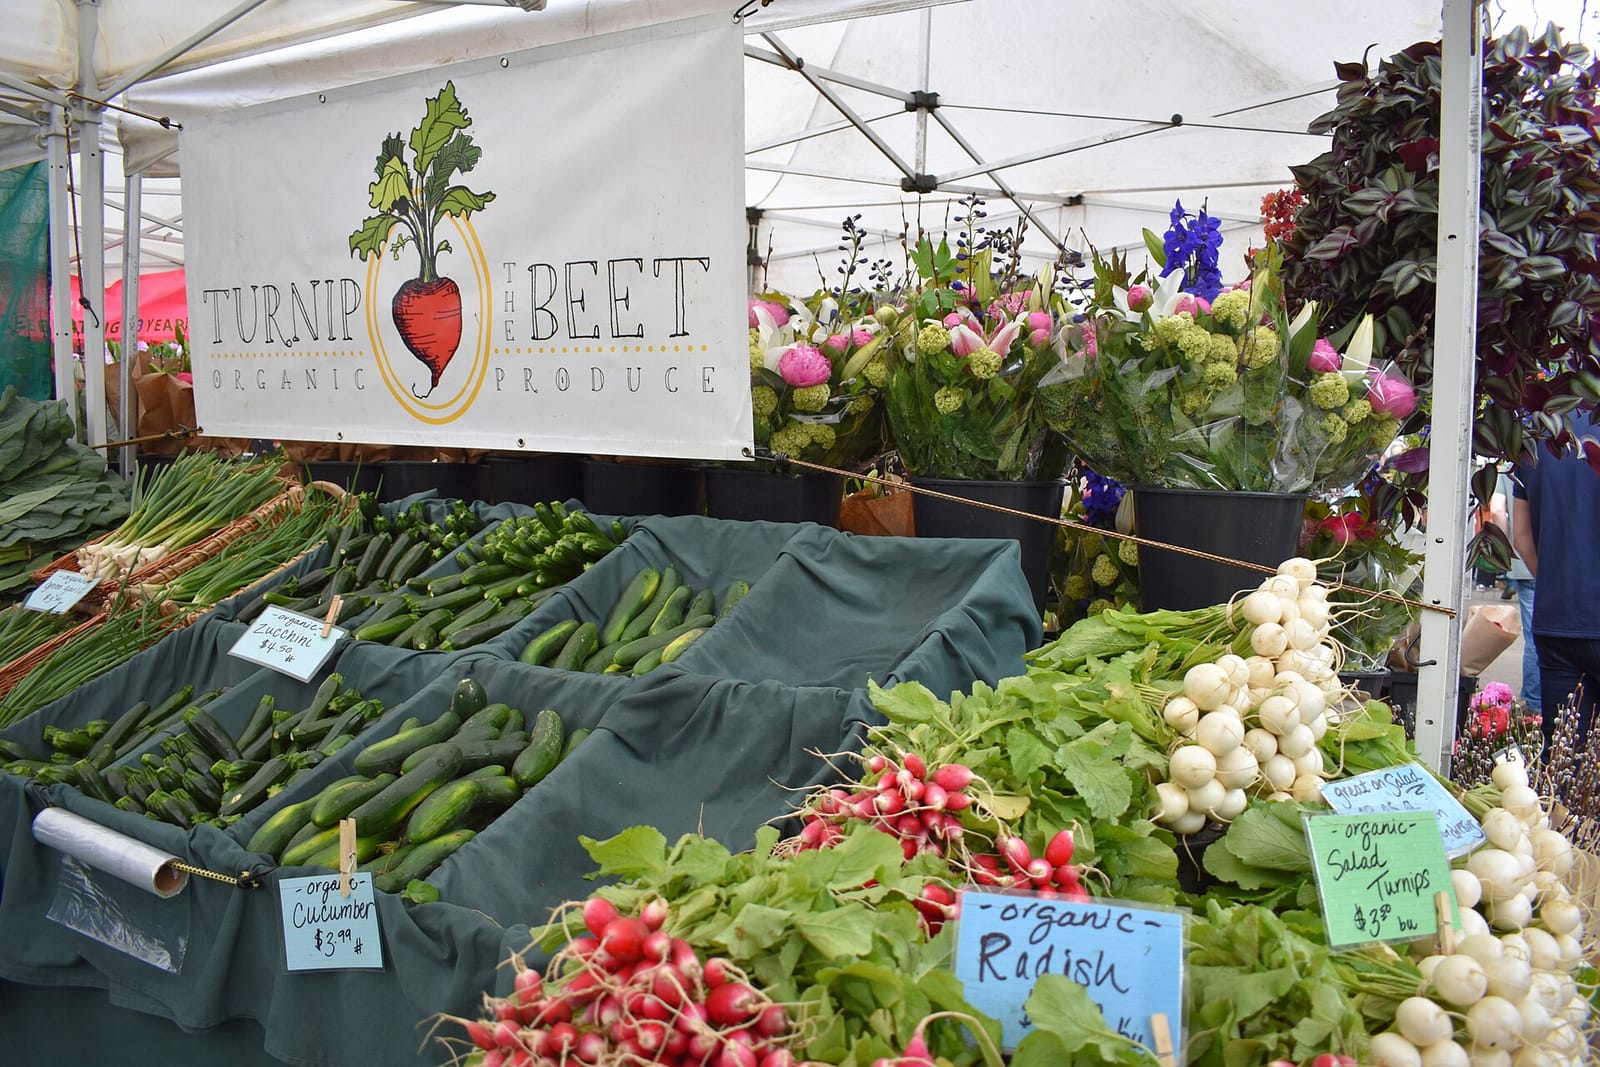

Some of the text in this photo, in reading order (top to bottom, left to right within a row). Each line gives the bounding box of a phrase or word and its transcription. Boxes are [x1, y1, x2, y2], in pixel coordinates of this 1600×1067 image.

[203, 278, 361, 347] TURNIP
[528, 257, 710, 341] BEET
[212, 366, 715, 393] ORGANIC PRODUCE
[253, 623, 316, 648] Zucchini
[1334, 783, 1370, 809] great
[1327, 844, 1388, 881] Salad
[1367, 868, 1431, 901] Turnips
[293, 899, 376, 928] Cucumber
[1399, 916, 1418, 932] bu
[978, 931, 1130, 994] Radish
